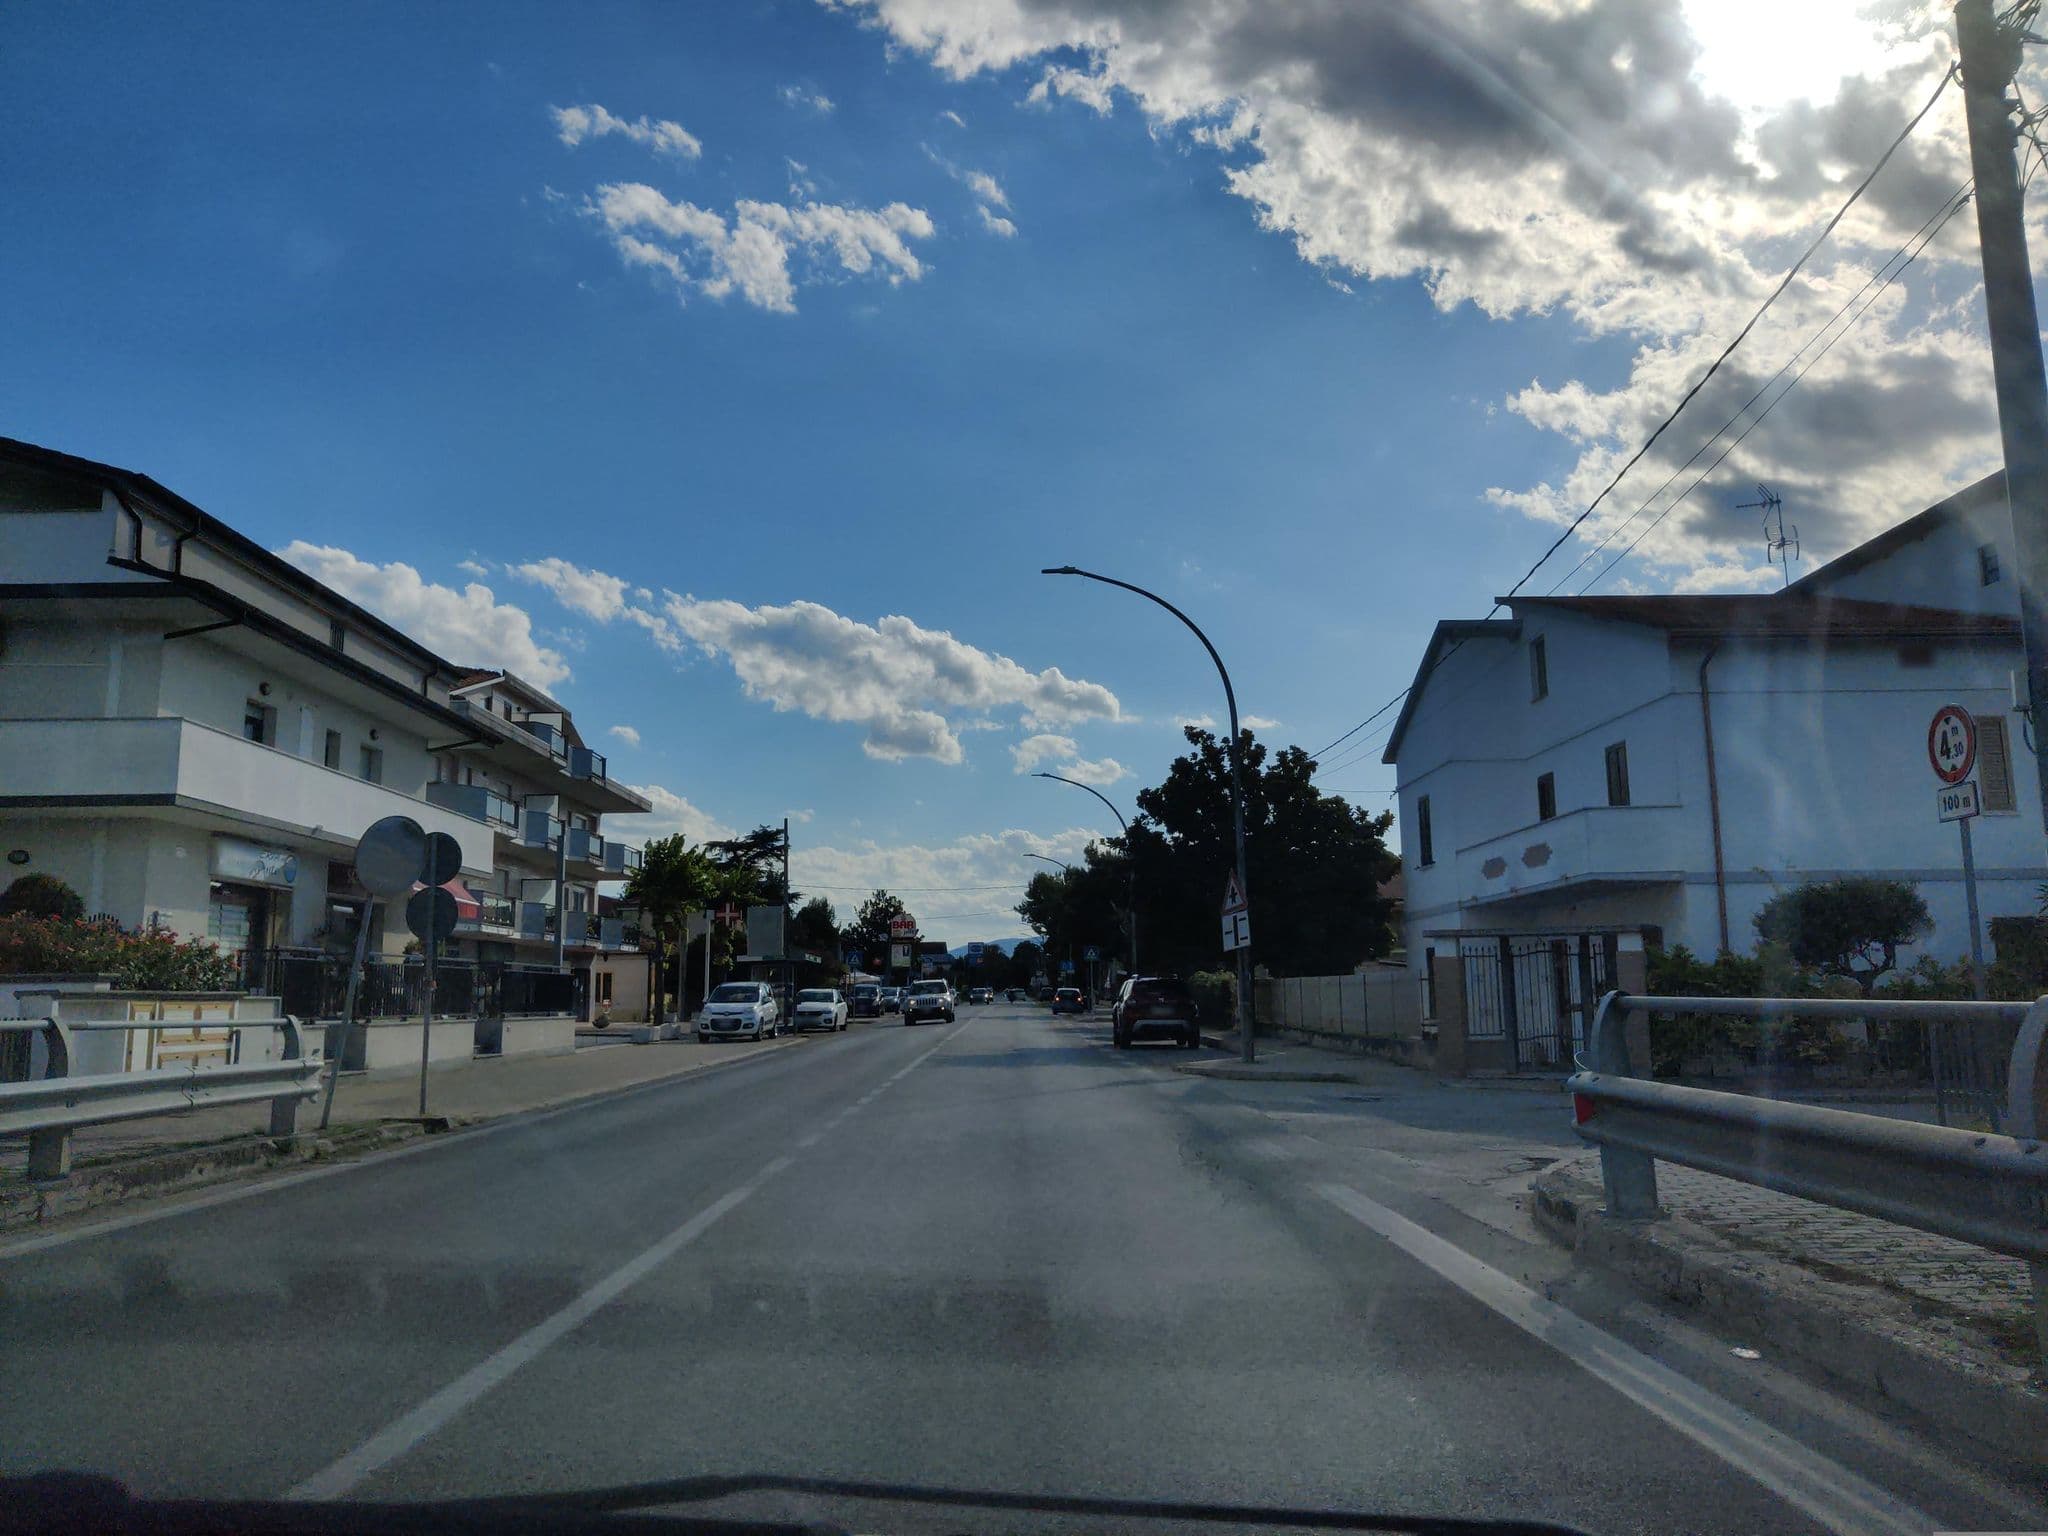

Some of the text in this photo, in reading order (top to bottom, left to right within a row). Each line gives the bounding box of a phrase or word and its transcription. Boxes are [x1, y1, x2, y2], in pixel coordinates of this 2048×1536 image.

[1951, 726, 1959, 737] m
[1942, 794, 1971, 813] 100 m
[892, 920, 914, 929] BAR
